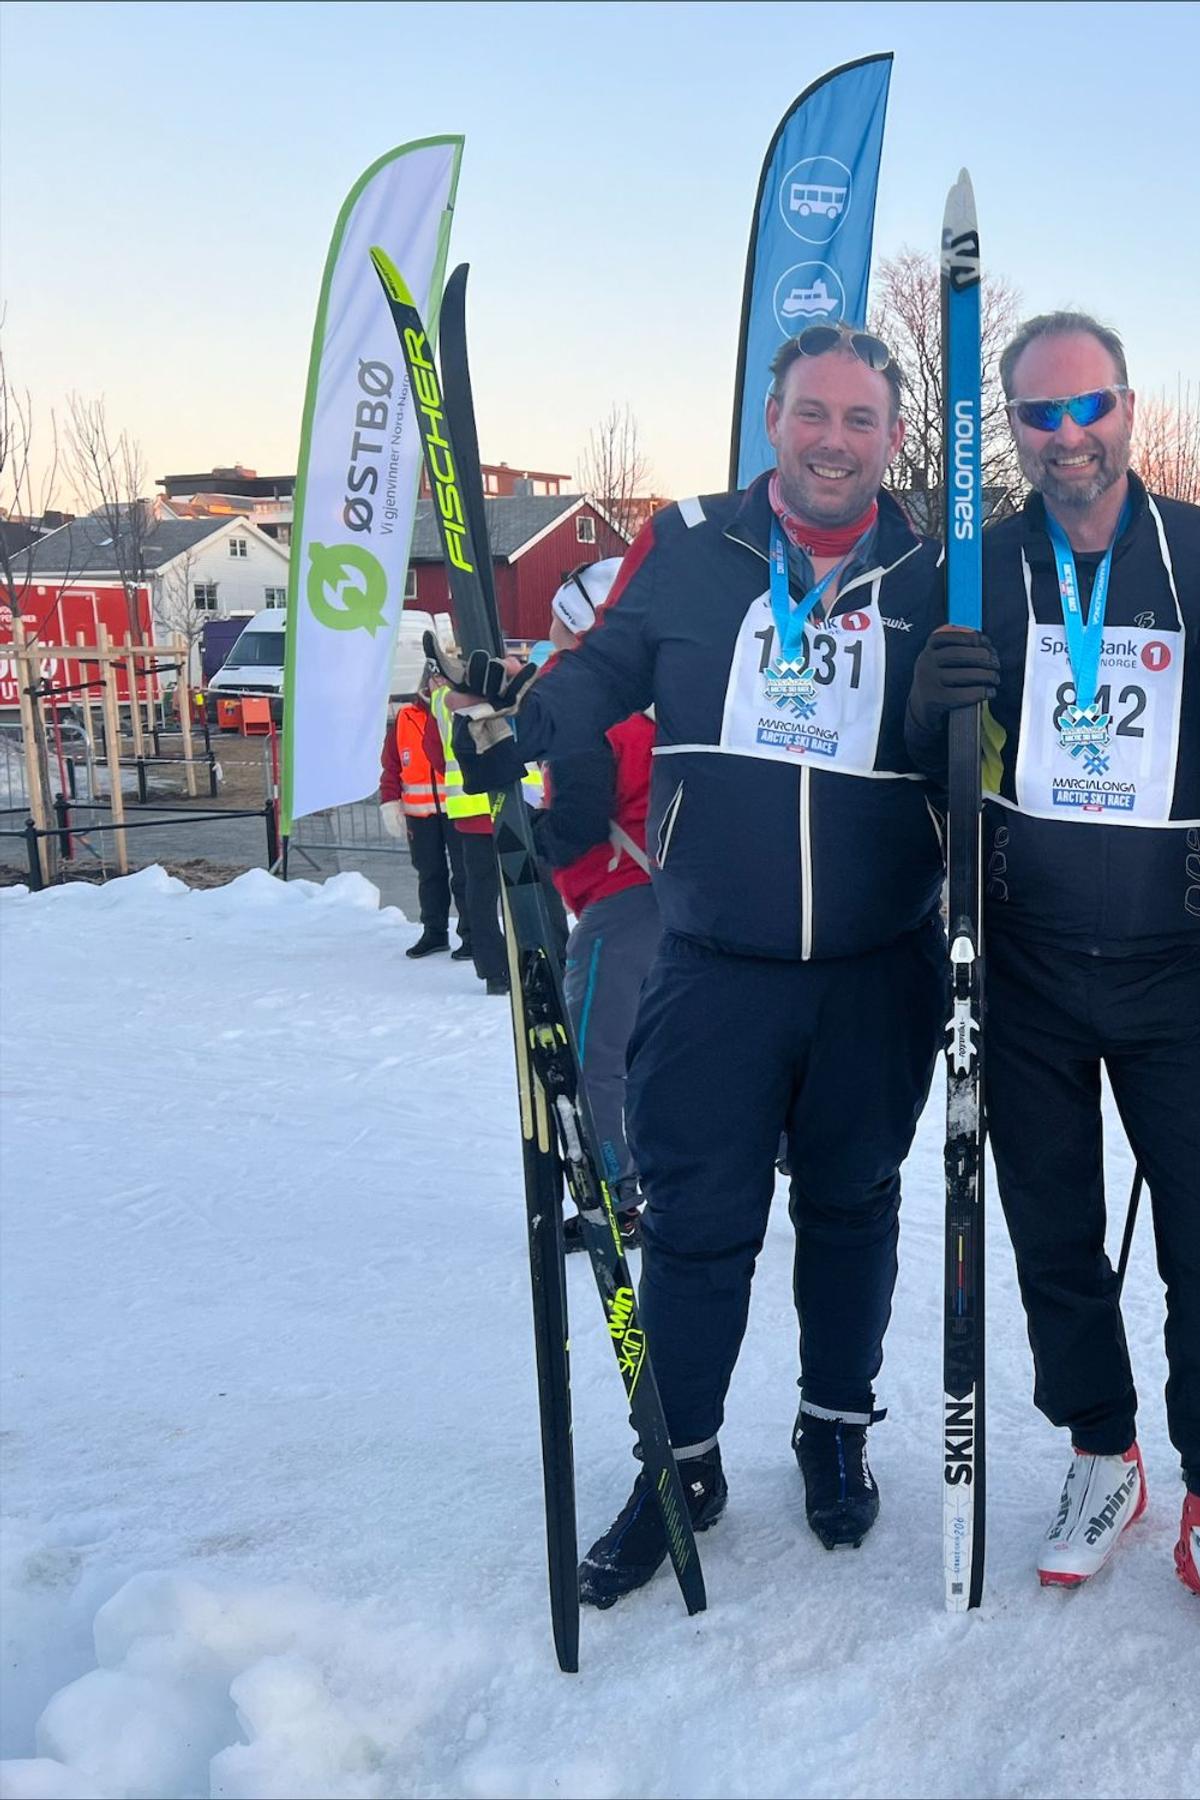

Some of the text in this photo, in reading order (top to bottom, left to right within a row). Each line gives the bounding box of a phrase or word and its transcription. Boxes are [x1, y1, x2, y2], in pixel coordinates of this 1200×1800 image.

[343, 358, 395, 534] ØSTBØ
[404, 327, 473, 574] FISCHER
[955, 400, 974, 540] salomon
[383, 447, 400, 519] gjenvinner
[380, 522, 393, 535] Vi
[758, 718, 839, 741] MARCIALONGA
[761, 730, 793, 745] ARCTIC
[794, 735, 810, 749] SKI
[811, 738, 833, 753] RACE
[1053, 778, 1136, 793] MARCIALONGA
[1057, 790, 1131, 808] ARCTIC SKI RACE
[944, 1402, 973, 1486] SKIN
[1083, 1465, 1138, 1546] alpina
